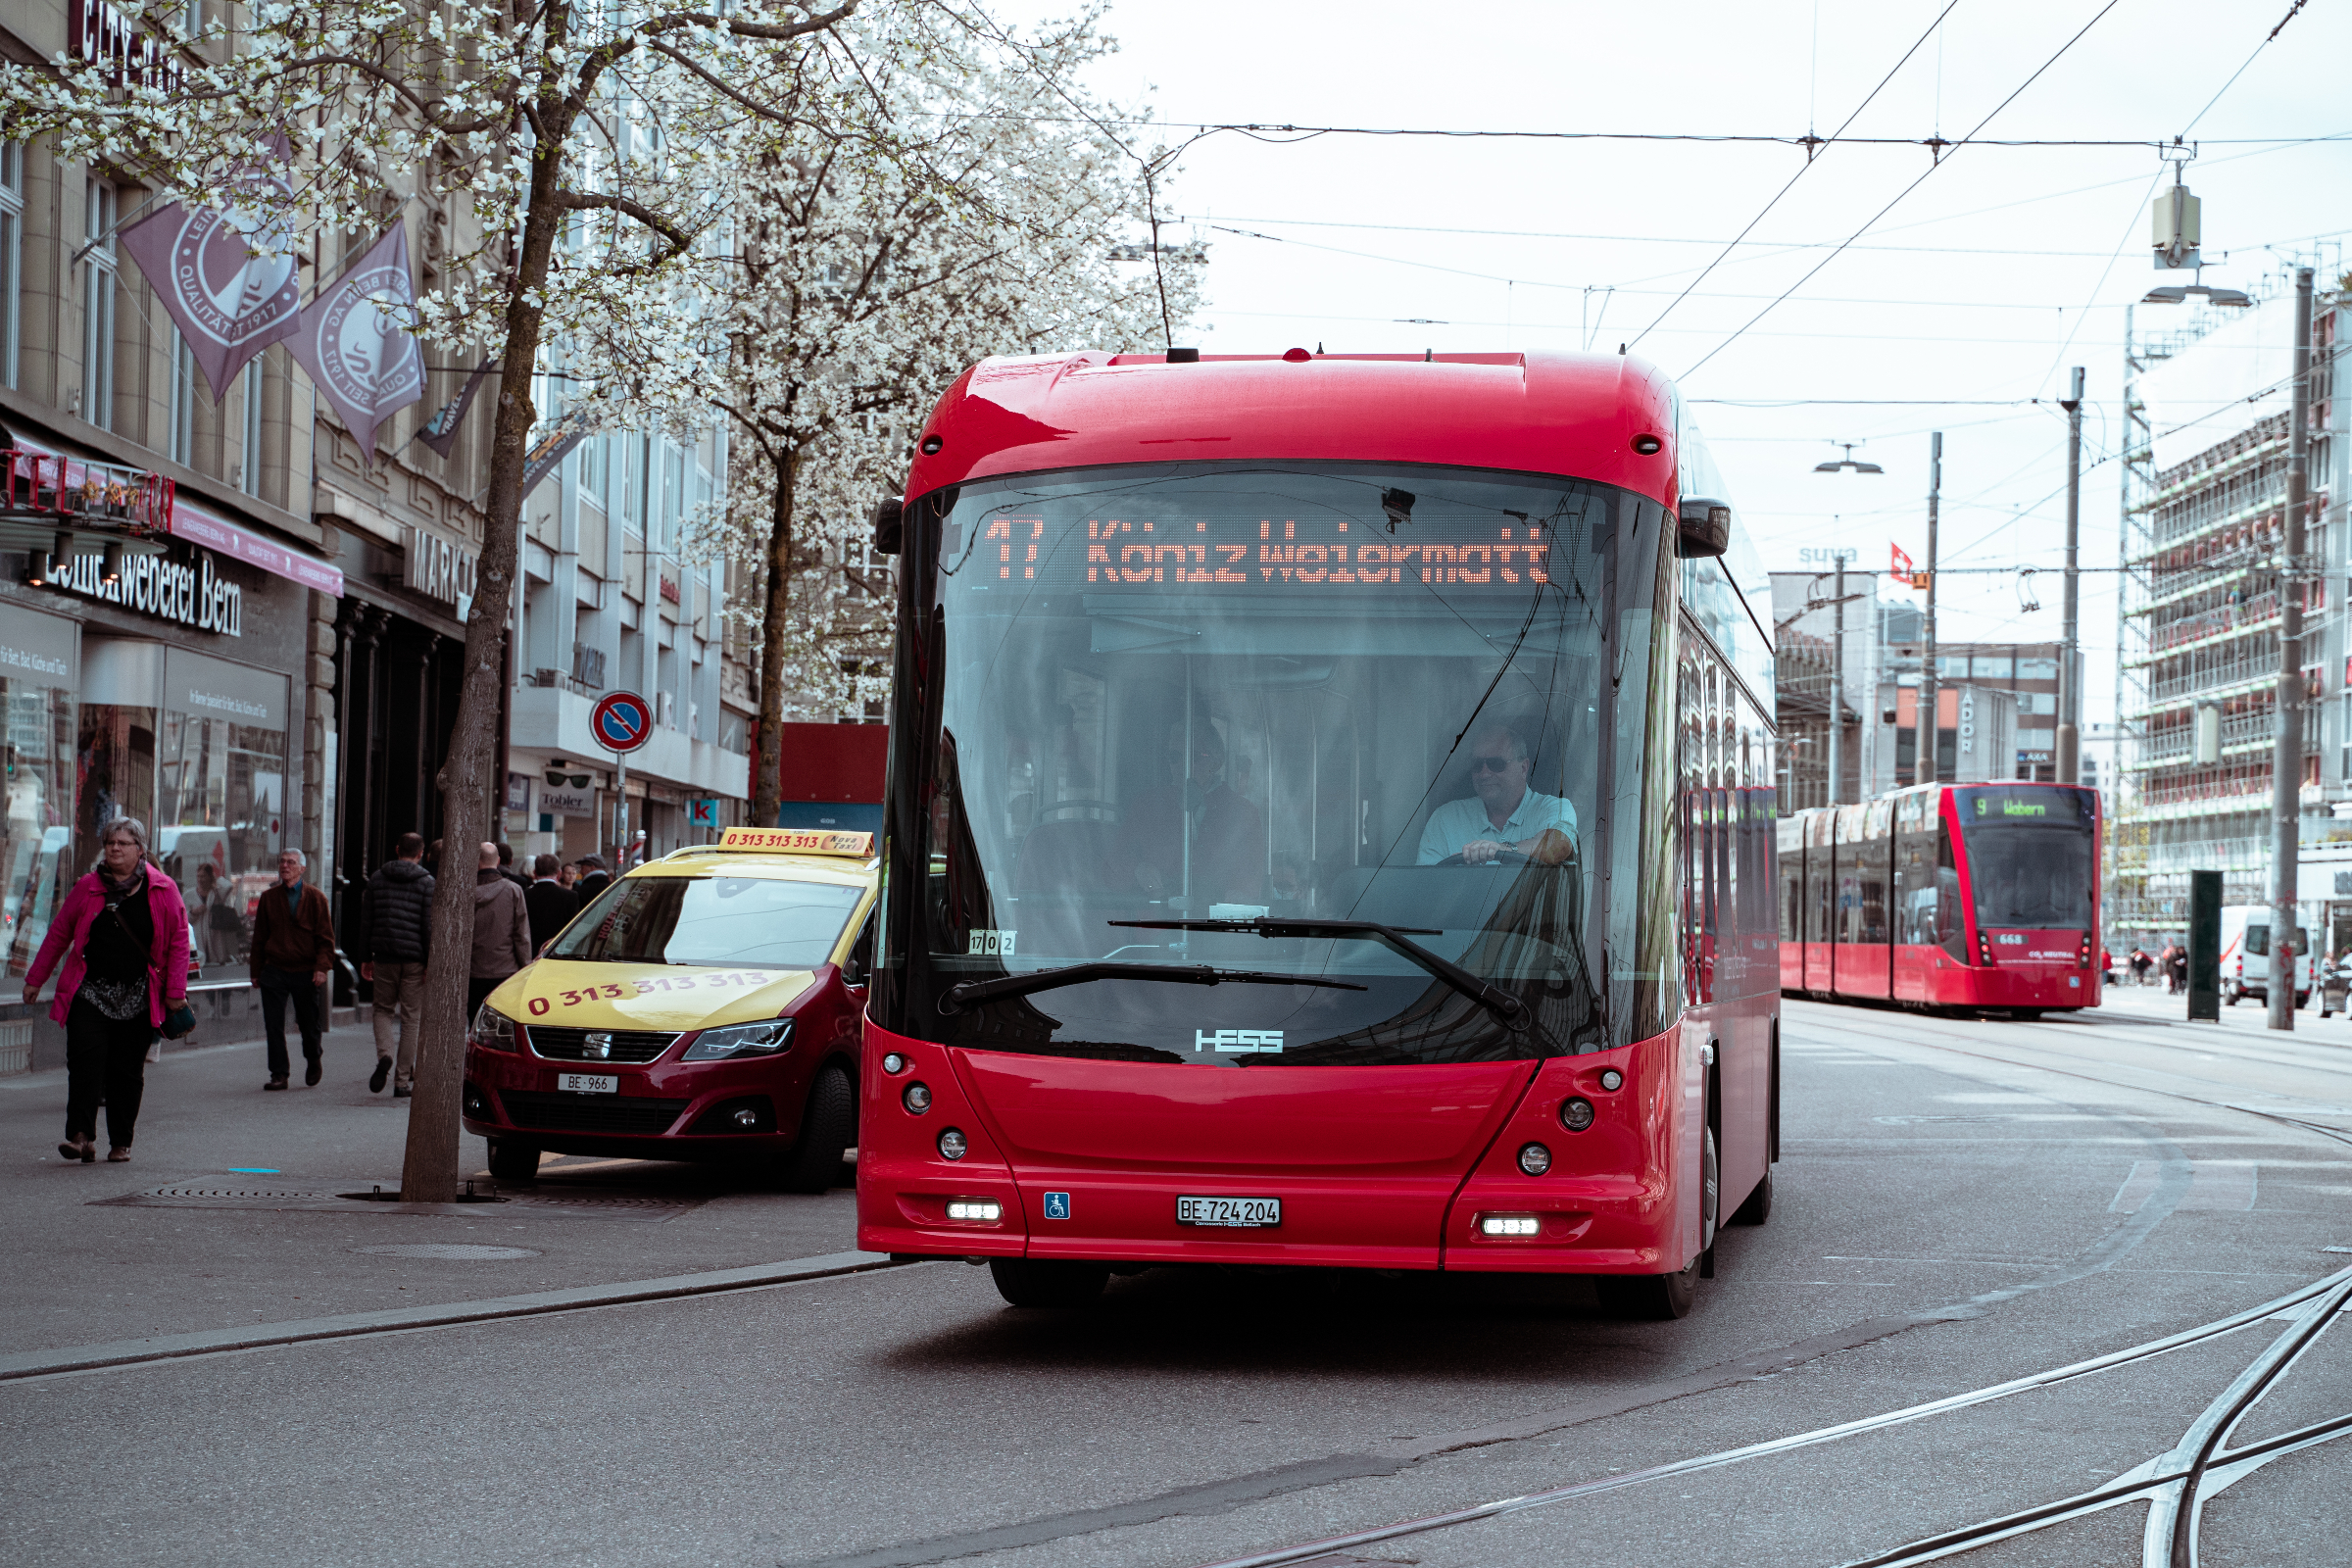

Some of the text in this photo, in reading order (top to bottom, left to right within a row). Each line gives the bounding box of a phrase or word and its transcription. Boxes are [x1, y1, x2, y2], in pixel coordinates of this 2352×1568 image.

[180, 265, 233, 334] QUALITÄT
[247, 302, 277, 329] 1917
[442, 395, 463, 435] TRAVEL
[522, 459, 547, 483] AVEL
[985, 514, 1548, 583] 17 Köniz Weiermatt
[1799, 547, 1857, 563] suva
[199, 551, 241, 637] Bern
[2027, 753, 2049, 762] AXA
[542, 793, 583, 806] Tobler
[1977, 799, 2045, 815] 9 Wabern
[727, 834, 819, 848] 0 313 313 313
[830, 835, 858, 844] Nova
[528, 972, 768, 1016] 0 313 313 313
[1196, 1029, 1284, 1053] HESS
